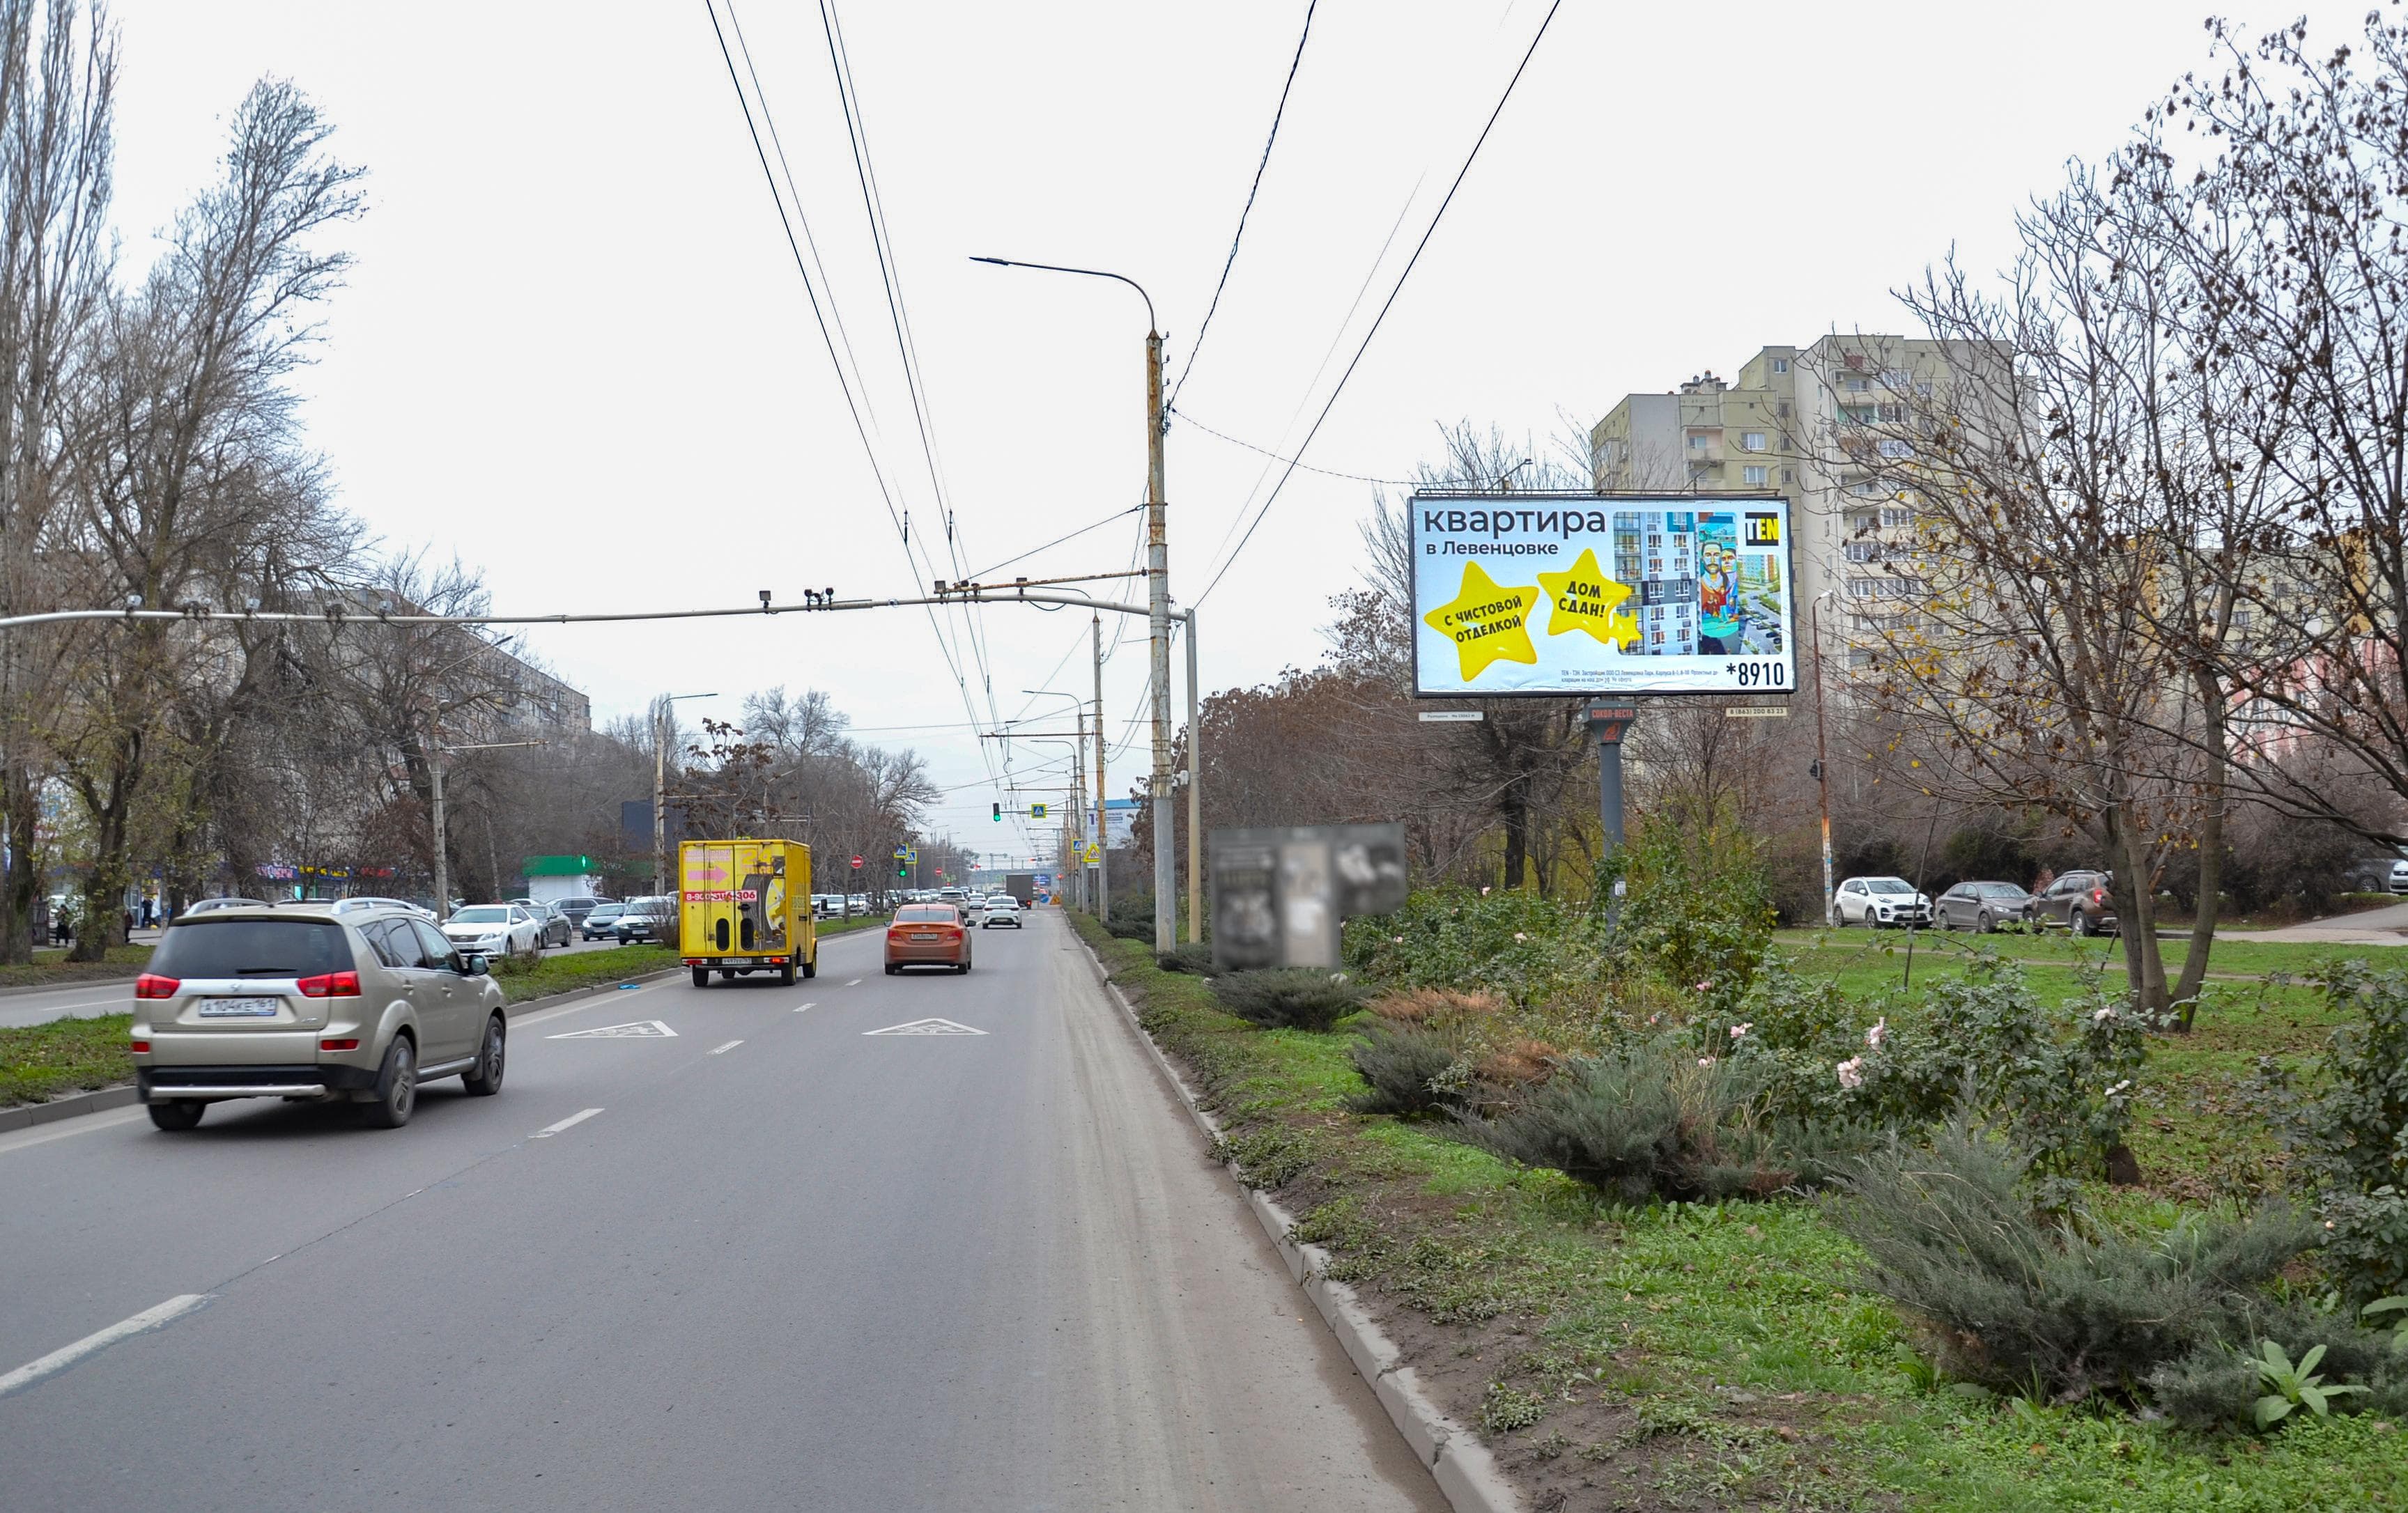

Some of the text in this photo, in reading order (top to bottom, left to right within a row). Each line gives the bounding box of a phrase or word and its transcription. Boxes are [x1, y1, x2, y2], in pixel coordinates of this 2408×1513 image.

[1424, 511, 1606, 540] квартира
[1745, 518, 1779, 540] TEN
[1426, 541, 1559, 557] в Левенцовке
[1566, 581, 1601, 598] ДОМ
[1444, 595, 1522, 626] С ЧИСТОВОЙ
[1559, 598, 1605, 619] СДАН!
[1456, 615, 1522, 643] ОТДЕЛКОЙ
